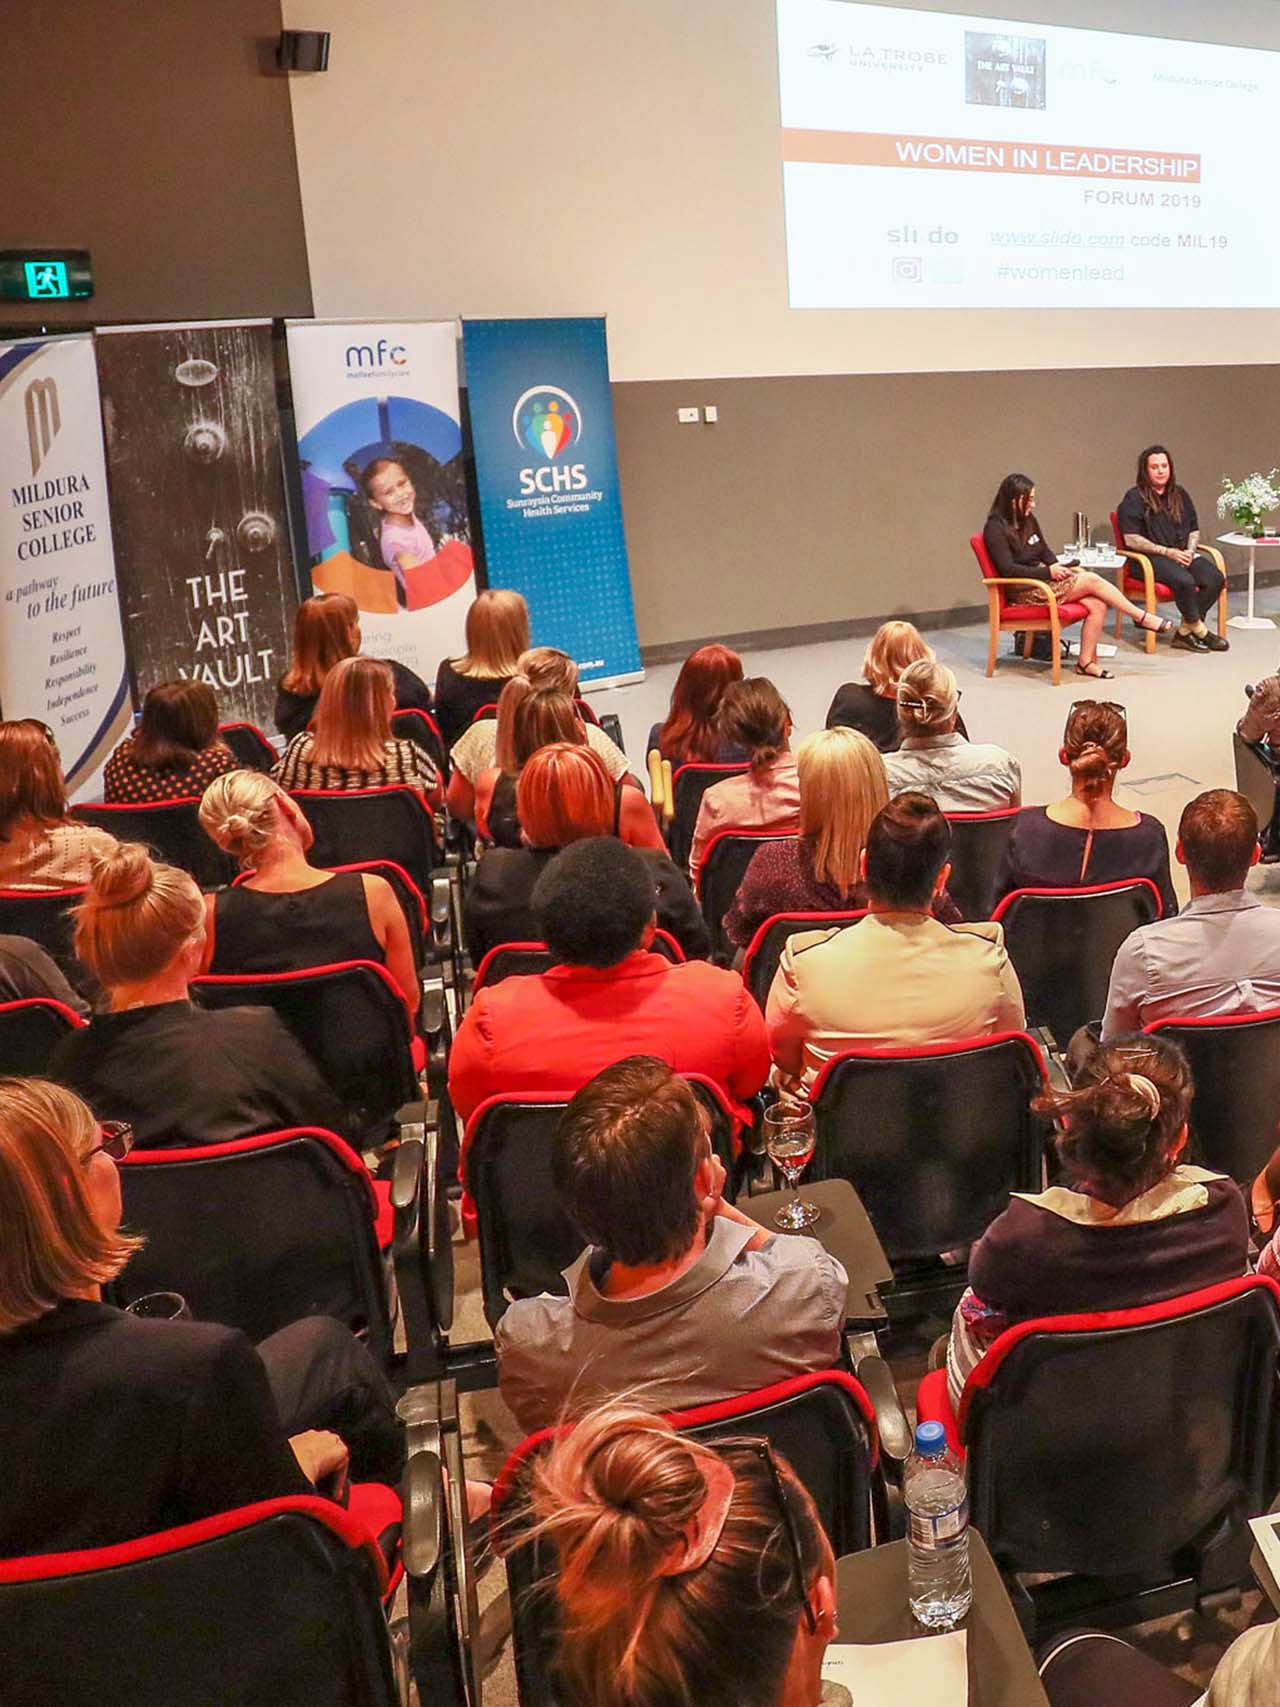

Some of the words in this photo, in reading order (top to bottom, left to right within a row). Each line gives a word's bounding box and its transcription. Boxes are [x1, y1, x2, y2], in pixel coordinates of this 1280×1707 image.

[880, 48, 949, 64] TROBE
[895, 140, 1005, 168] WOMEN
[1011, 148, 1039, 169] IN
[1045, 151, 1198, 177] LEADERSHIP
[1083, 189, 1155, 207] FORUM
[1160, 192, 1202, 208] 2019
[1130, 234, 1172, 248] code
[1176, 234, 1230, 249] MIL19
[997, 263, 1125, 282] #womenlead
[345, 339, 407, 367] mfc
[11, 472, 91, 508] MILDURA
[519, 463, 588, 495] SCHS
[506, 494, 550, 509] Sunraysia
[550, 490, 604, 504] Community
[523, 505, 553, 519] Health
[553, 503, 590, 516] Services
[22, 500, 85, 532] SENIOR
[17, 523, 97, 561] COLLEGE
[5, 591, 14, 602] a
[16, 576, 59, 603] pathway
[27, 601, 41, 620] to
[45, 591, 68, 613] the
[69, 579, 116, 611] future
[185, 569, 249, 609] THE
[51, 625, 82, 645] Respect
[195, 611, 250, 653] ART
[49, 646, 88, 667] Resilience
[44, 663, 97, 690] Responsibility
[47, 684, 99, 711] Independence
[60, 707, 90, 727] Success
